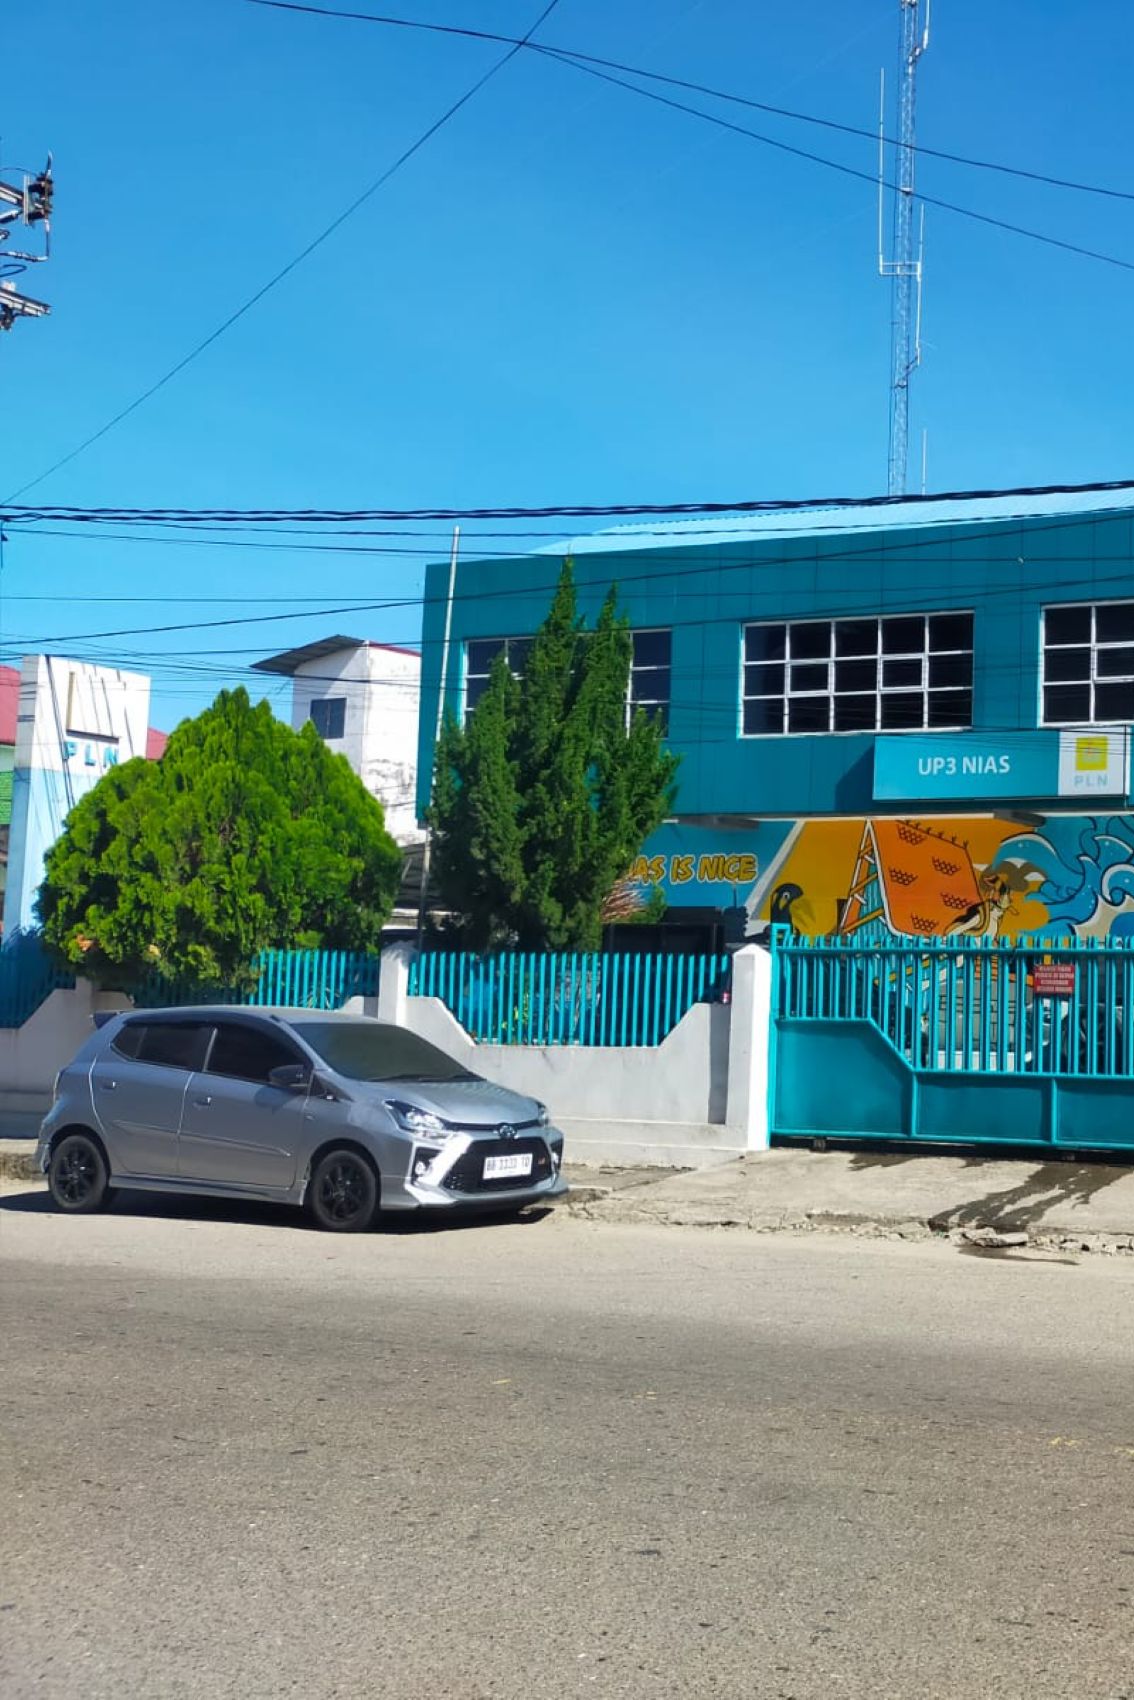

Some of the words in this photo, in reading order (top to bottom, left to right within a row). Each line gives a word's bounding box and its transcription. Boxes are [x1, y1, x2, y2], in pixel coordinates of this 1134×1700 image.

[62, 741, 119, 768] PLN
[918, 757, 957, 775] UP3
[962, 755, 1010, 774] NIAS
[1074, 775, 1108, 787] PLN
[671, 855, 694, 884] IS
[698, 854, 758, 884] NICE
